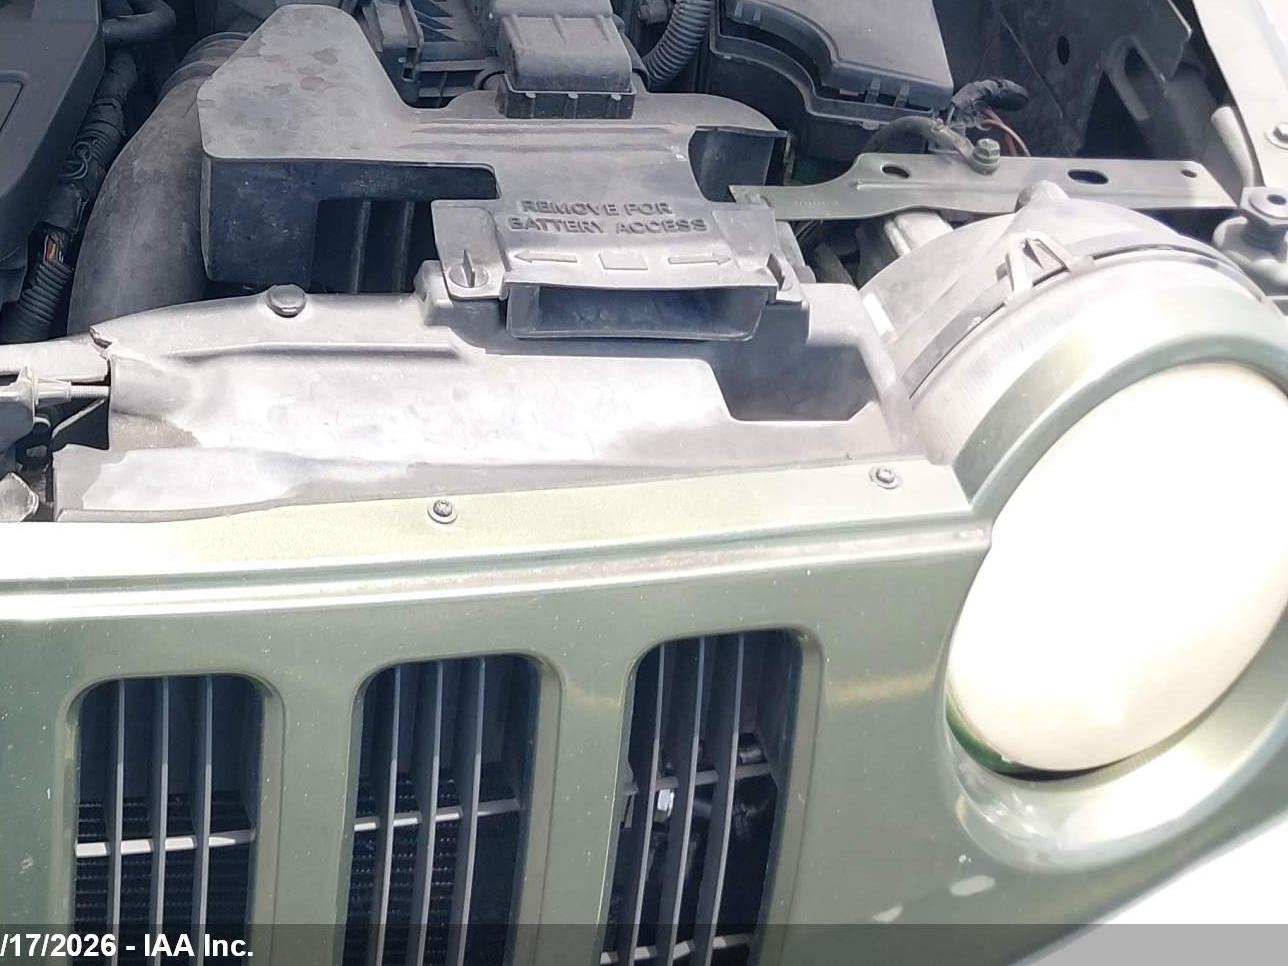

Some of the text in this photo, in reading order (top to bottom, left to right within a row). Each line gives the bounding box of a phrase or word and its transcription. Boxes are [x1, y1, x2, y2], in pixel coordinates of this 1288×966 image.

[520, 200, 676, 216] REMOVE FOR
[509, 217, 708, 234] BATTERY ACCESS
